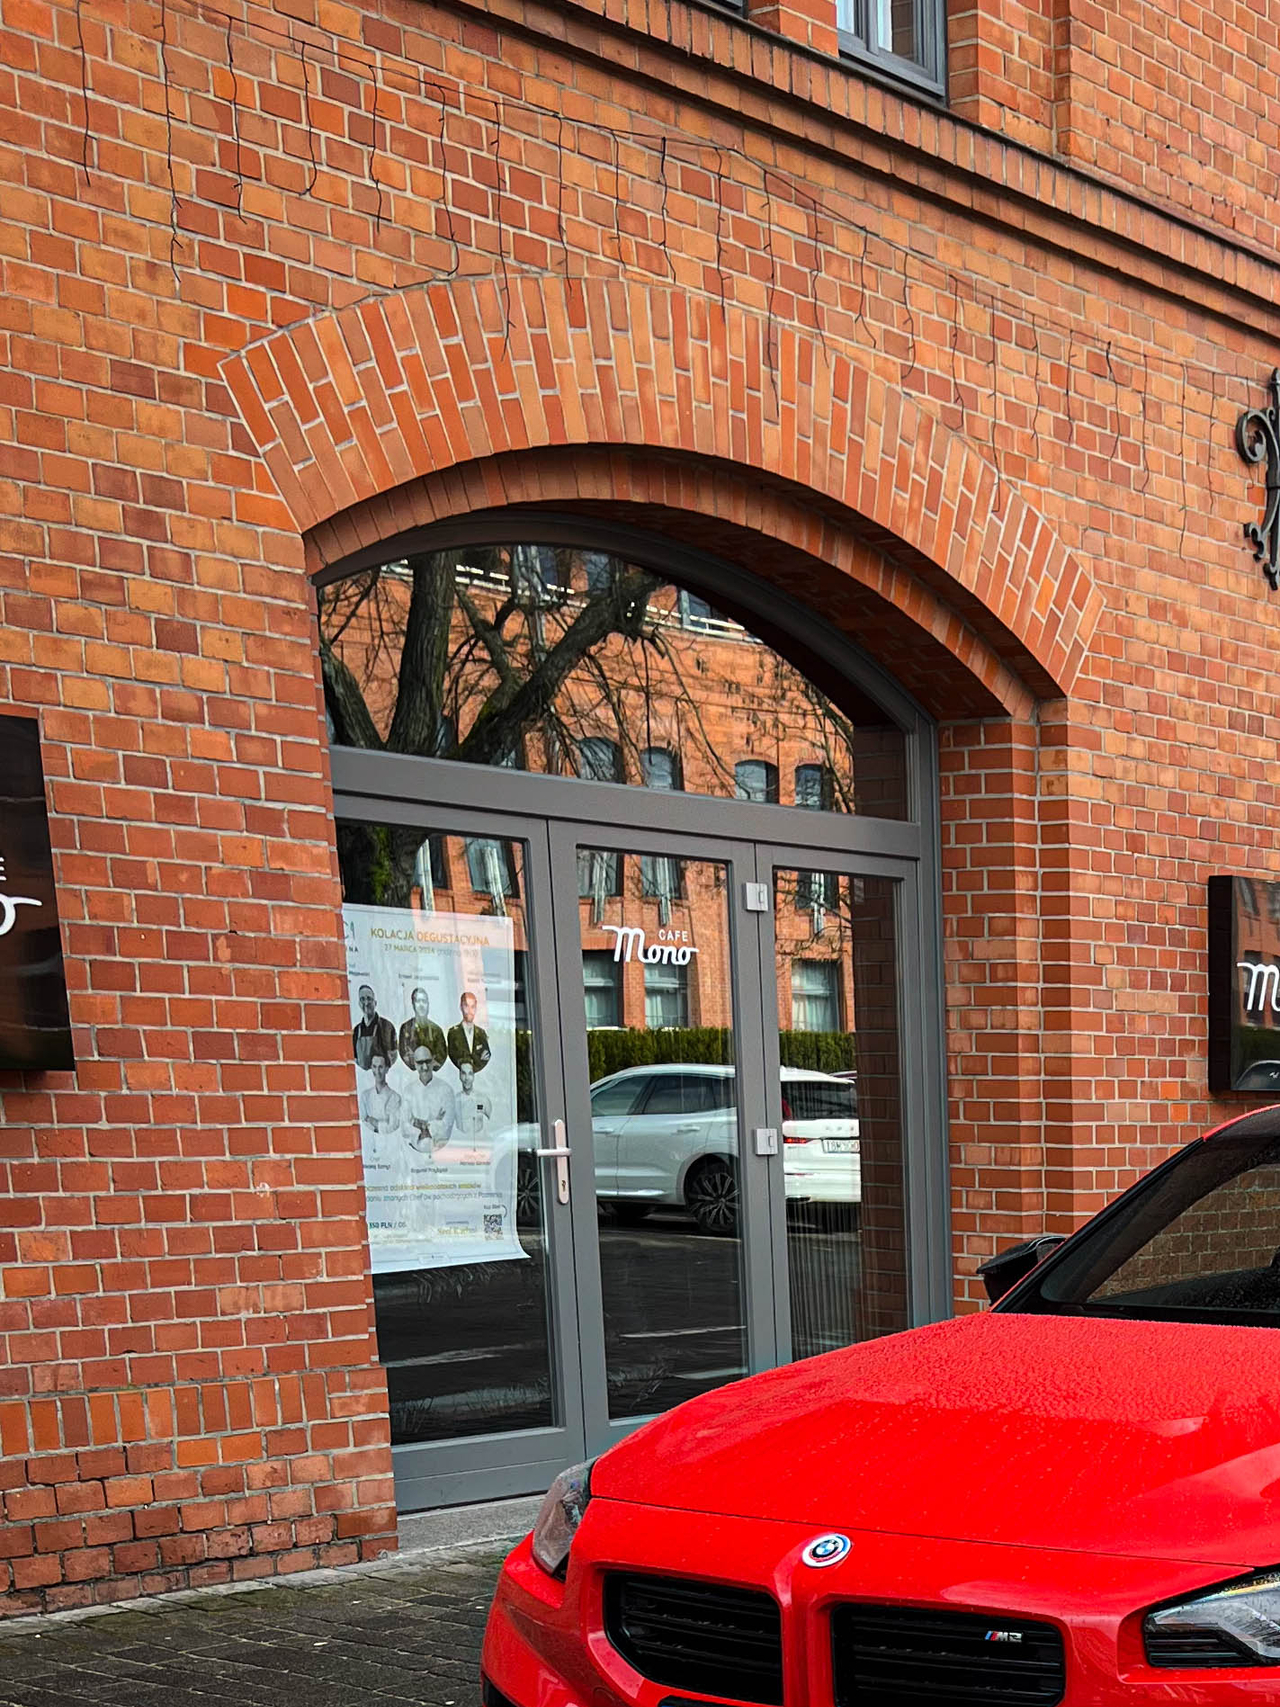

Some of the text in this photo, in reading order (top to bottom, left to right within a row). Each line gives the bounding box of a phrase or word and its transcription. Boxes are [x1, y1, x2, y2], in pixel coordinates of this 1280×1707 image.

[371, 928, 414, 941] KOLACJA
[416, 932, 490, 946] DEGUSTACYJNA
[601, 925, 700, 965] Mono
[659, 930, 688, 942] CAFE
